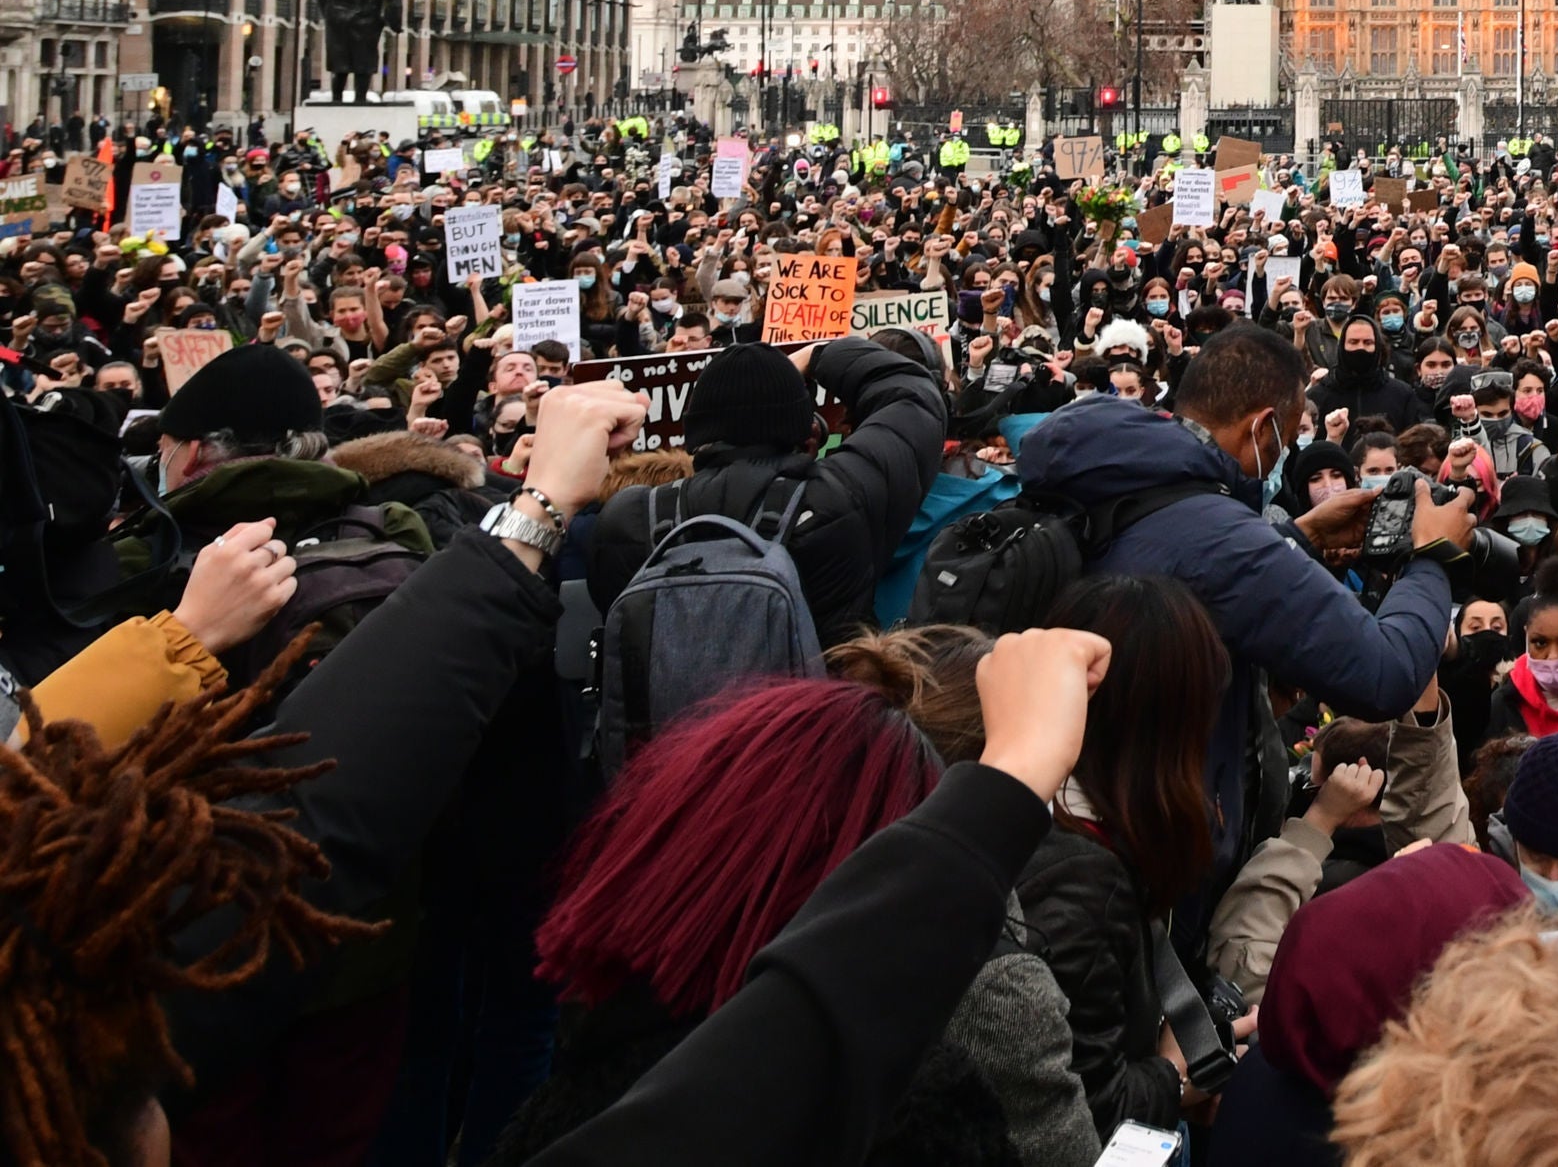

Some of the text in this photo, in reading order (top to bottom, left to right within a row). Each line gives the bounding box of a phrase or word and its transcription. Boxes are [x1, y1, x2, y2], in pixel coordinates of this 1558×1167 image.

[1061, 140, 1101, 176] 97%
[452, 222, 487, 241] BUT
[449, 241, 497, 257] ENOUGH
[455, 255, 495, 276] MEN
[777, 259, 846, 280] WE ARE
[517, 296, 573, 307] Tear down
[772, 283, 846, 302] SICK TO
[517, 306, 570, 319] the sexist
[769, 302, 849, 327] DEATH OF
[850, 296, 944, 330] SILENCE
[517, 319, 556, 331] system
[605, 364, 634, 382] do
[643, 358, 678, 377] not
[632, 426, 662, 452] do
